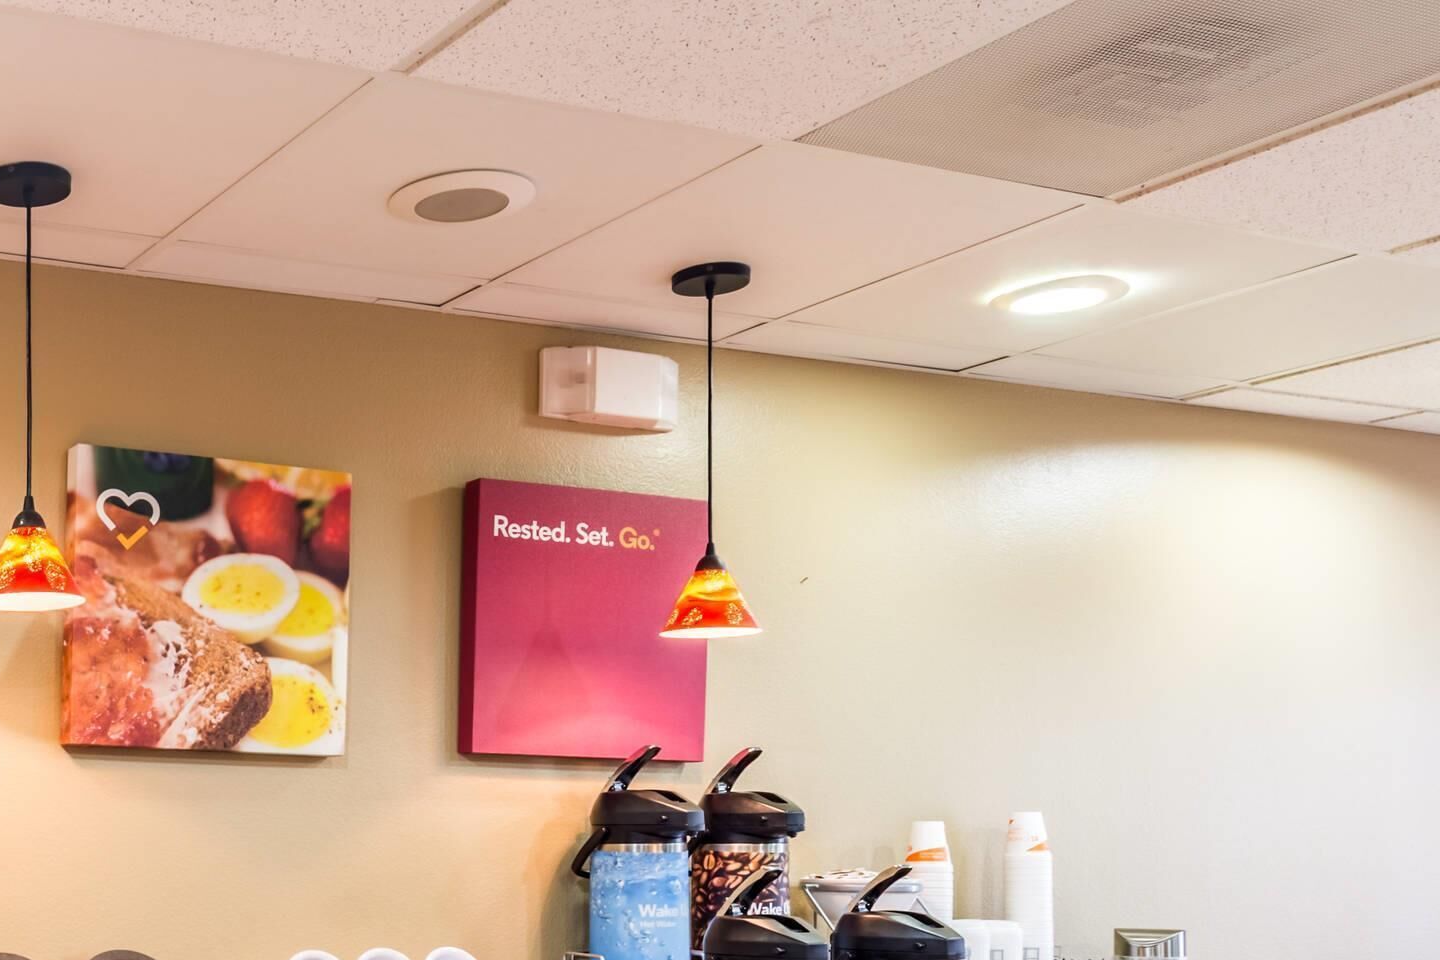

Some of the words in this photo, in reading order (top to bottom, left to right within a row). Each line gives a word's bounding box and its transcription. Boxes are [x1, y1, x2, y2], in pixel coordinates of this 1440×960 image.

[493, 514, 571, 544] Rested.
[576, 522, 614, 547] Set.
[638, 903, 679, 917] Wake
